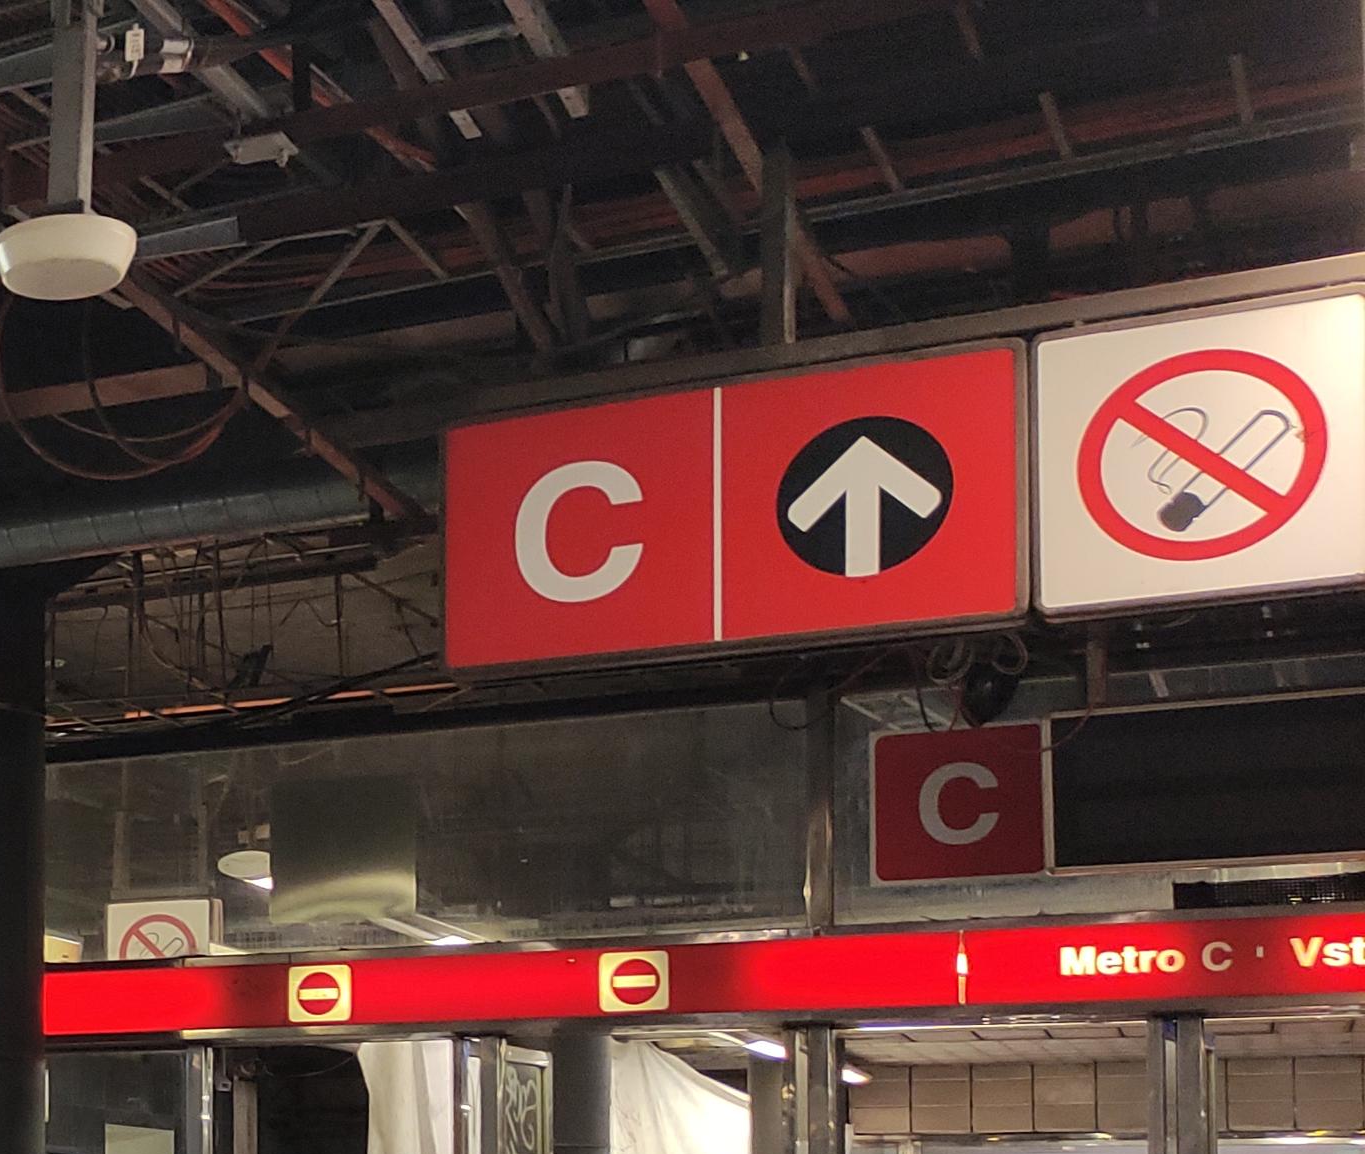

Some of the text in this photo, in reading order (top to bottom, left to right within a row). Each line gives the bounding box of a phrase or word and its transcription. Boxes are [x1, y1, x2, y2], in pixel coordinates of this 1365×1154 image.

[515, 460, 644, 603] C
[919, 762, 1000, 845] C
[1059, 945, 1186, 976] Metro
[1201, 941, 1233, 972] C
